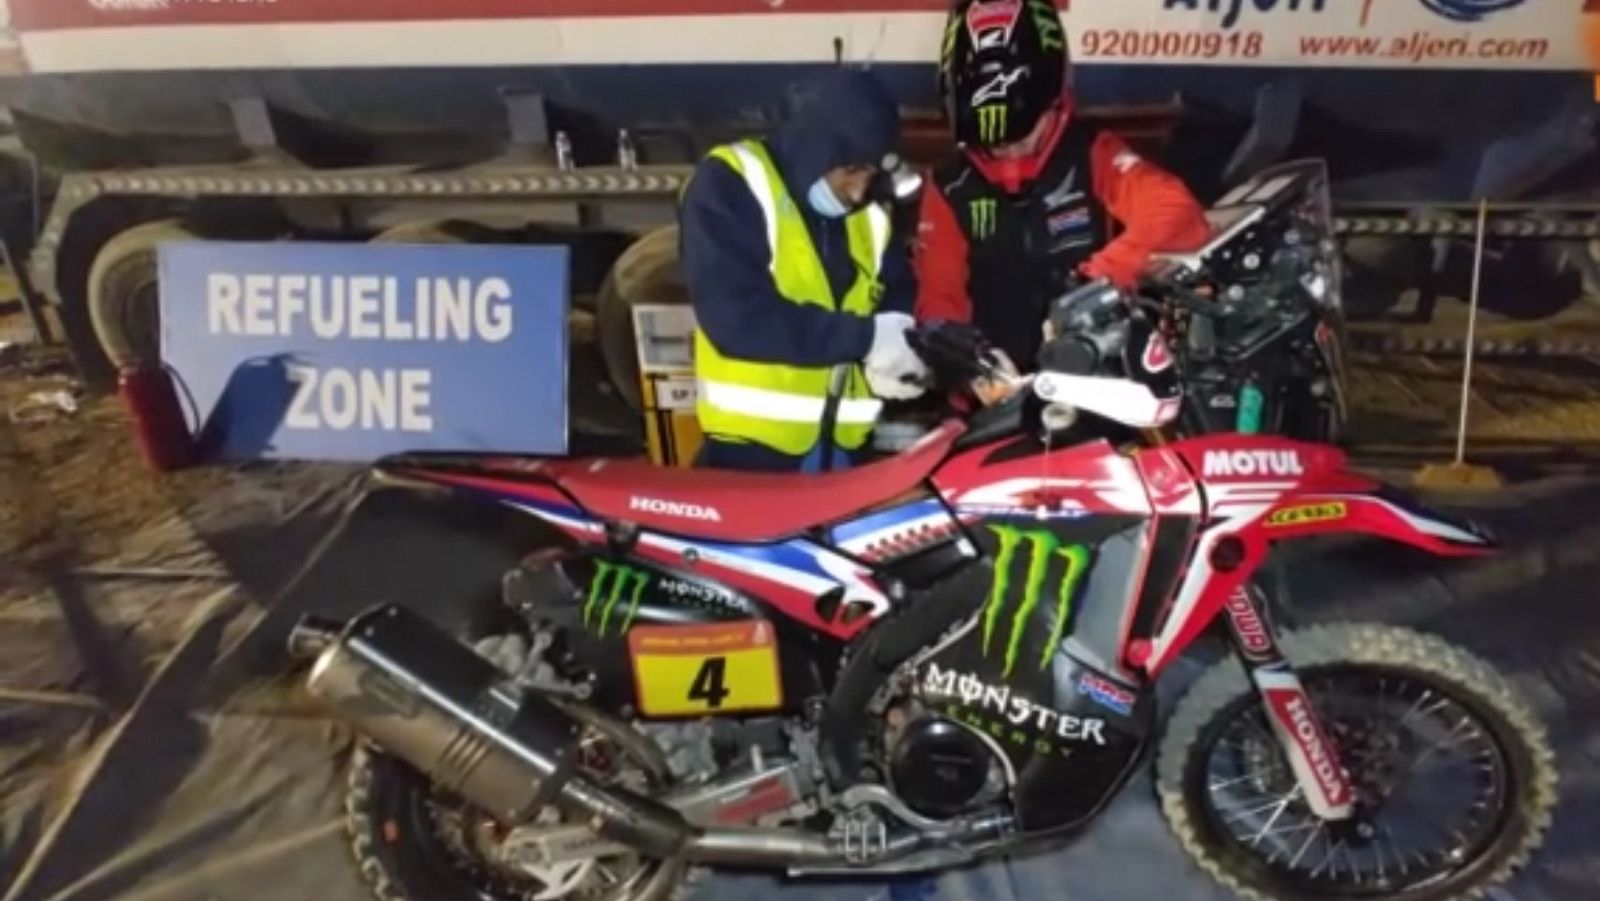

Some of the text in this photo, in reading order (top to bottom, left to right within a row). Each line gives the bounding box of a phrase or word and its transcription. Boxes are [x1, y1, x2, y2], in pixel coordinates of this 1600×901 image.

[1080, 29, 1550, 64] 920000918 www.aljeri.com
[207, 273, 513, 342] REFUELING
[284, 366, 434, 432] ZONE
[1203, 450, 1304, 476] MOTUL
[629, 495, 722, 522] HONDA
[686, 656, 730, 708] 4
[923, 662, 1107, 746] MONSTER
[1285, 696, 1342, 803] HONDA
